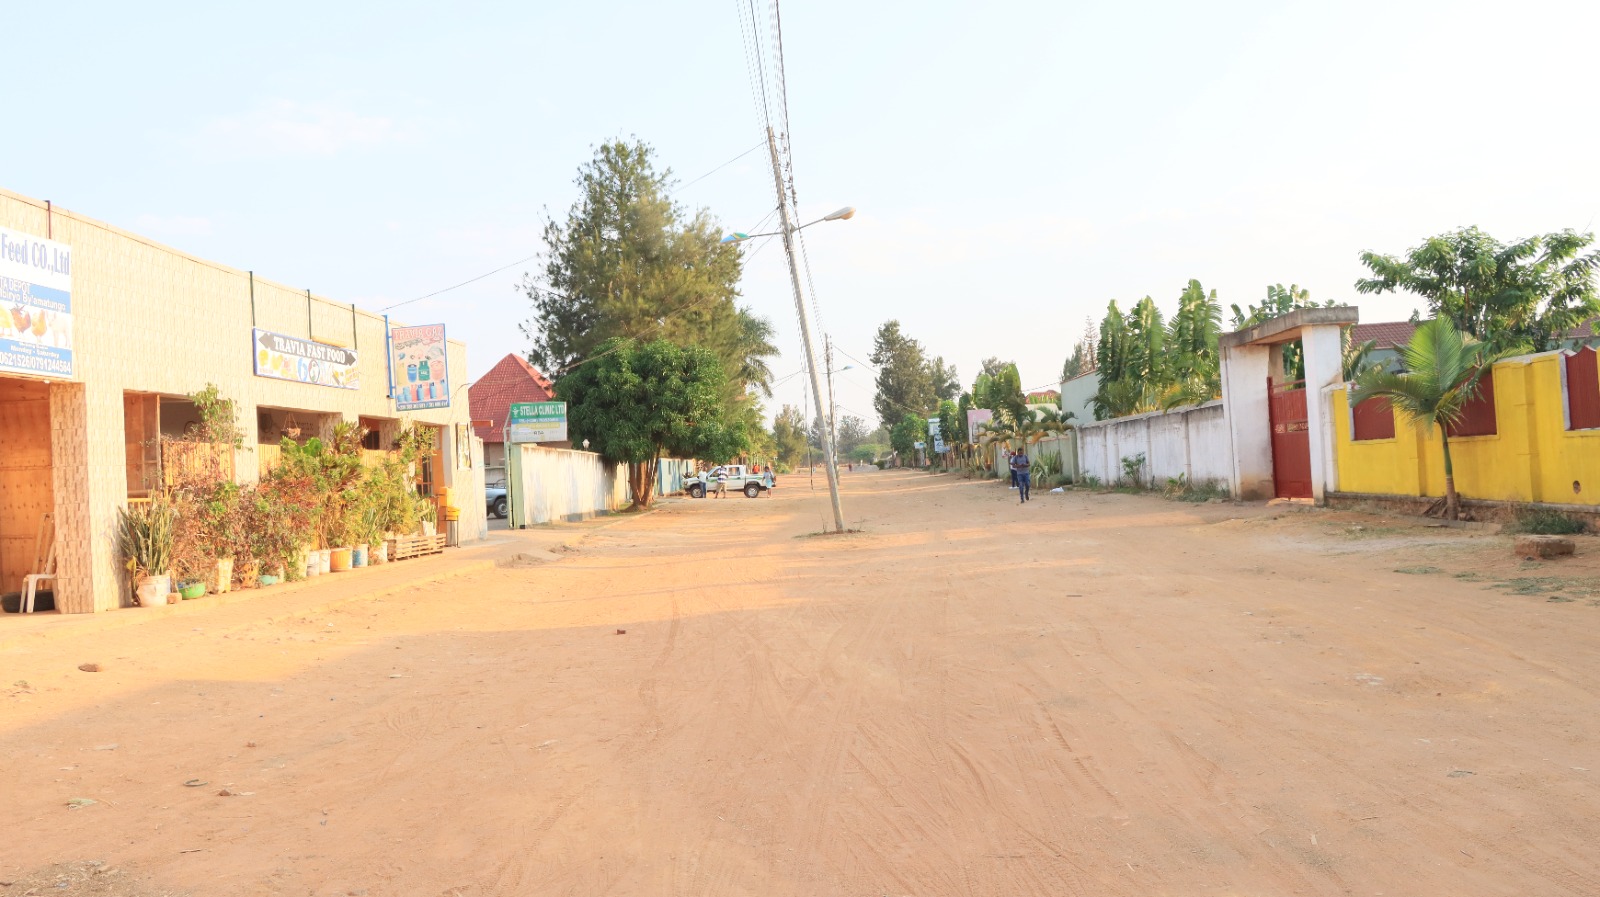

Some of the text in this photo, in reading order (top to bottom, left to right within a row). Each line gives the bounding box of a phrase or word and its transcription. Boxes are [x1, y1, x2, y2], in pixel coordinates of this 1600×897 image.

[2, 232, 28, 265] Feed
[274, 336, 346, 363] TRAVIA FAST FOOD
[520, 404, 564, 416] STELLA CLINIC LTD
